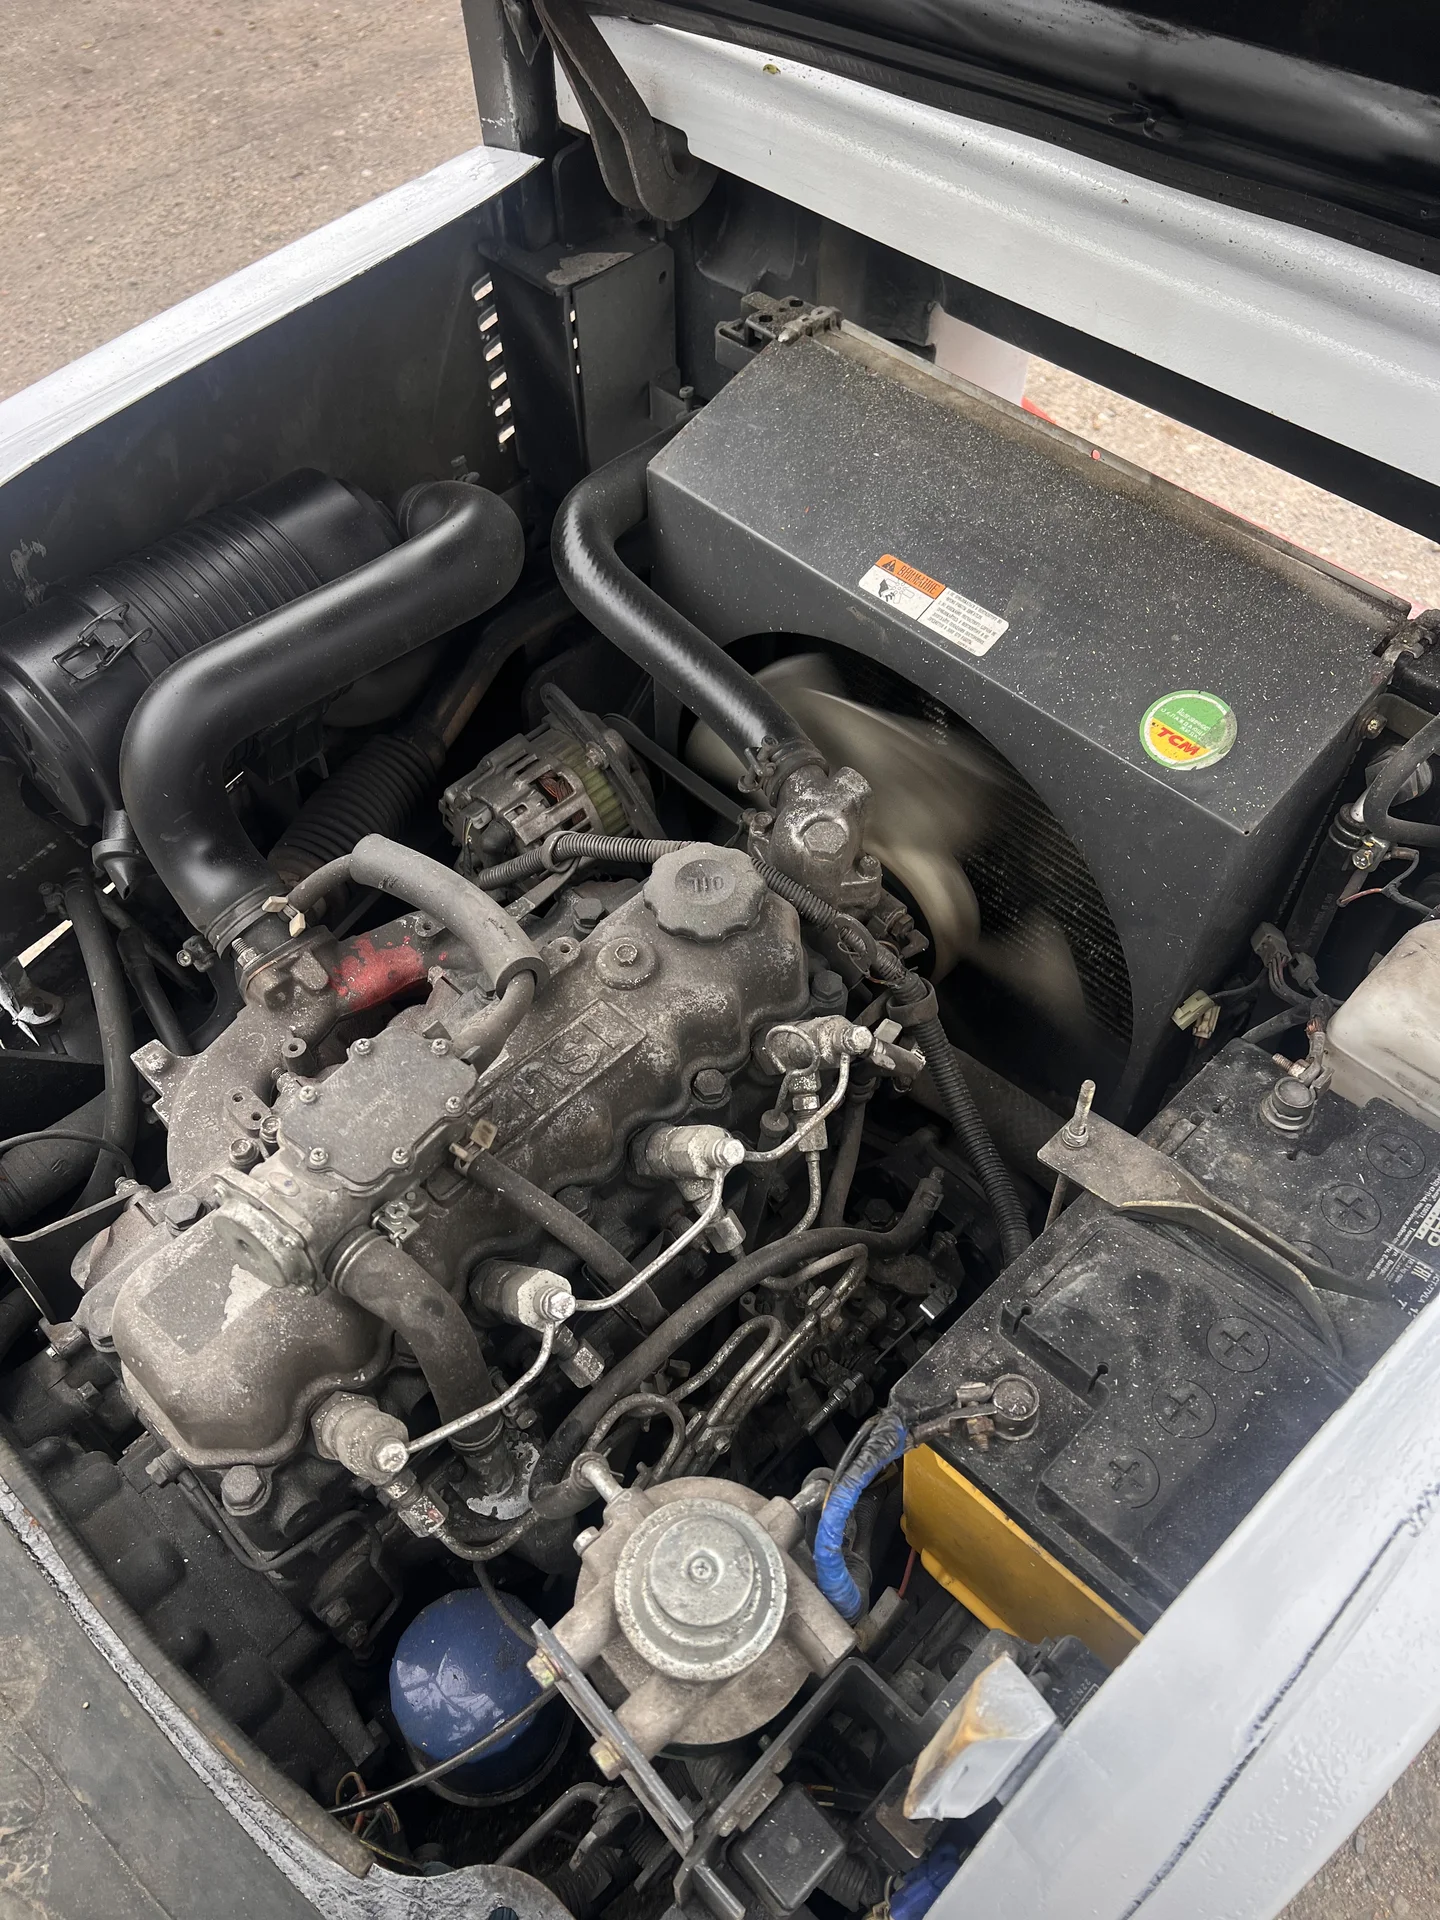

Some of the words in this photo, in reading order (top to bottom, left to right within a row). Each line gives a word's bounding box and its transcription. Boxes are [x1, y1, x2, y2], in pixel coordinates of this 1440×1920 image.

[898, 565, 940, 595] ВНИМАНИЕ
[1157, 727, 1201, 756] TCM
[687, 875, 724, 893] OIL
